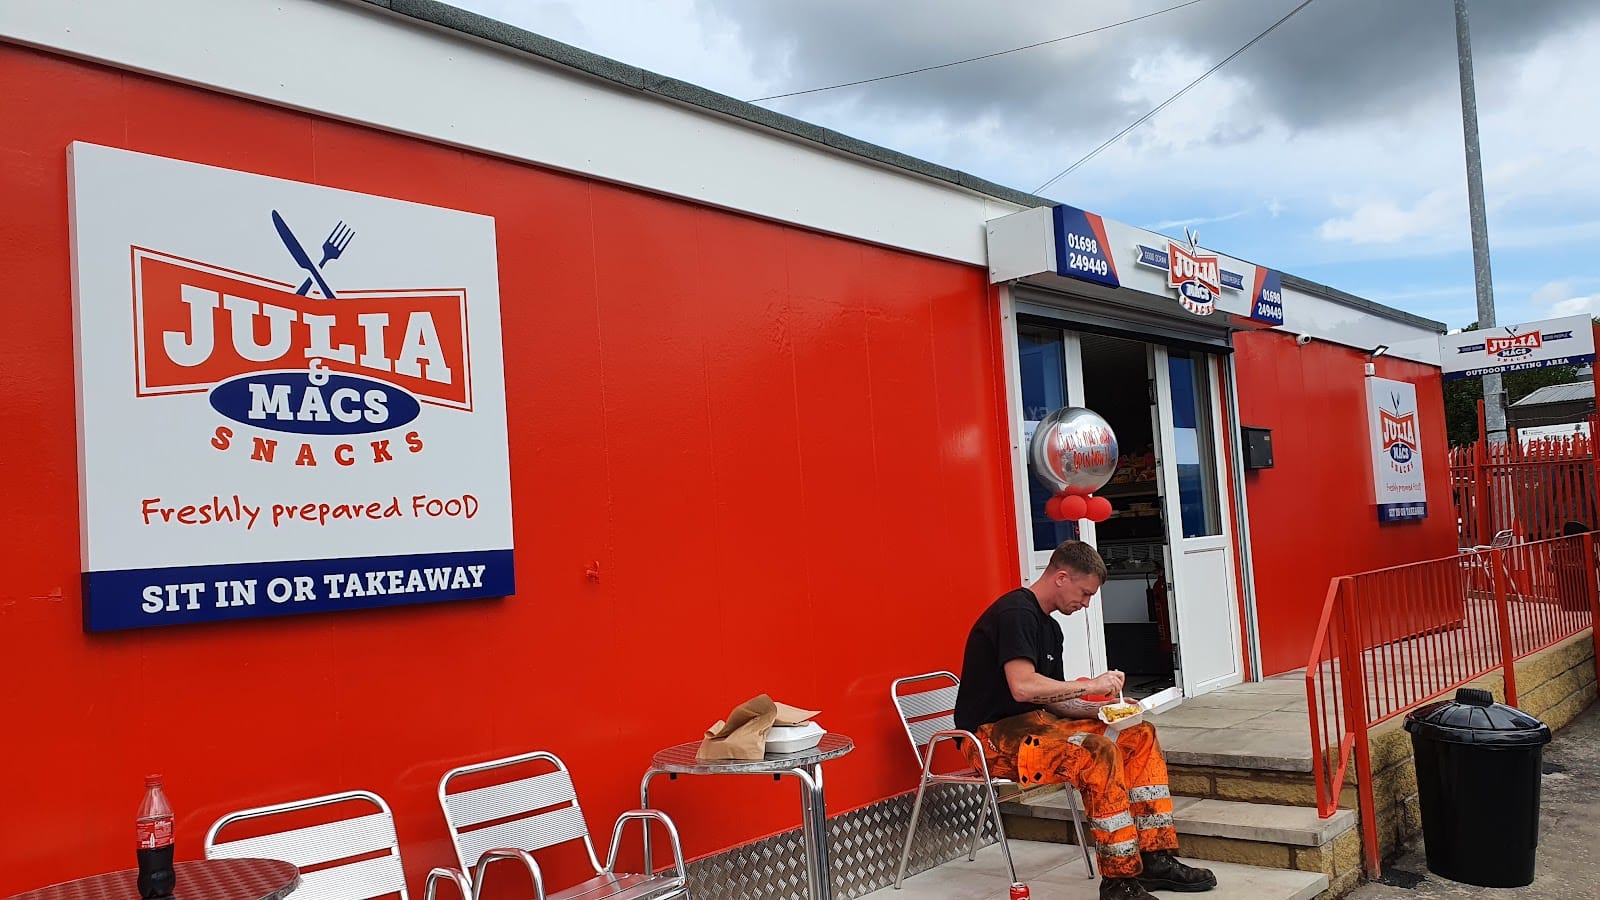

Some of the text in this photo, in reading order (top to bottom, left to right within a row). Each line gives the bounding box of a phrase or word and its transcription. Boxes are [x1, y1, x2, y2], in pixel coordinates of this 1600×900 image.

[1068, 232, 1097, 254] 01698
[1069, 252, 1108, 276] 249449
[1173, 250, 1220, 289] JULIA
[1262, 288, 1281, 304] 01698
[1258, 302, 1282, 320] 249449
[163, 283, 451, 384] JULIA
[1489, 334, 1539, 352] JULIA
[1502, 348, 1527, 357] MACS
[308, 358, 329, 386] &
[1465, 358, 1569, 377] OUTDOOR EATING AREA
[248, 383, 389, 424] MACS
[1383, 416, 1416, 446] JULIA
[211, 426, 424, 467] SNACKS
[141, 495, 261, 530] Freshly
[271, 496, 403, 527] prepared
[142, 564, 486, 613] SIT IN OR TAKEAWAY
